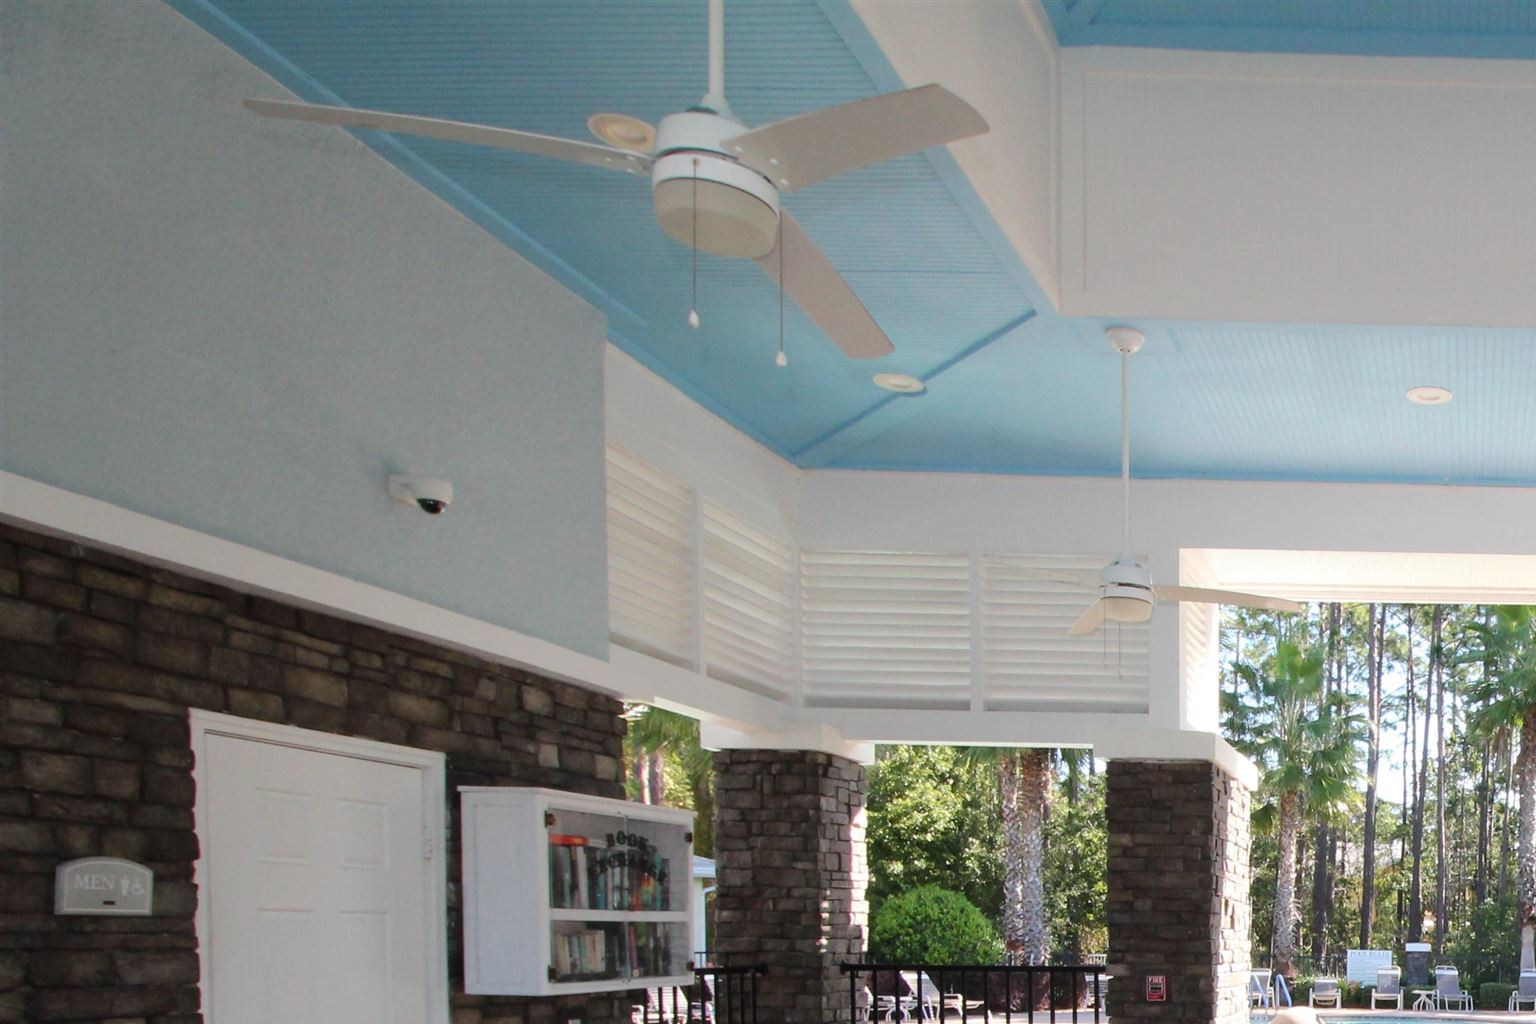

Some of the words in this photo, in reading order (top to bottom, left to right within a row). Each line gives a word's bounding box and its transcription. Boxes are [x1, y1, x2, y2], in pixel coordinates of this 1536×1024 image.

[605, 830, 648, 851] BOOK
[74, 874, 114, 890] MEN
[1149, 976, 1163, 984] FIRE
